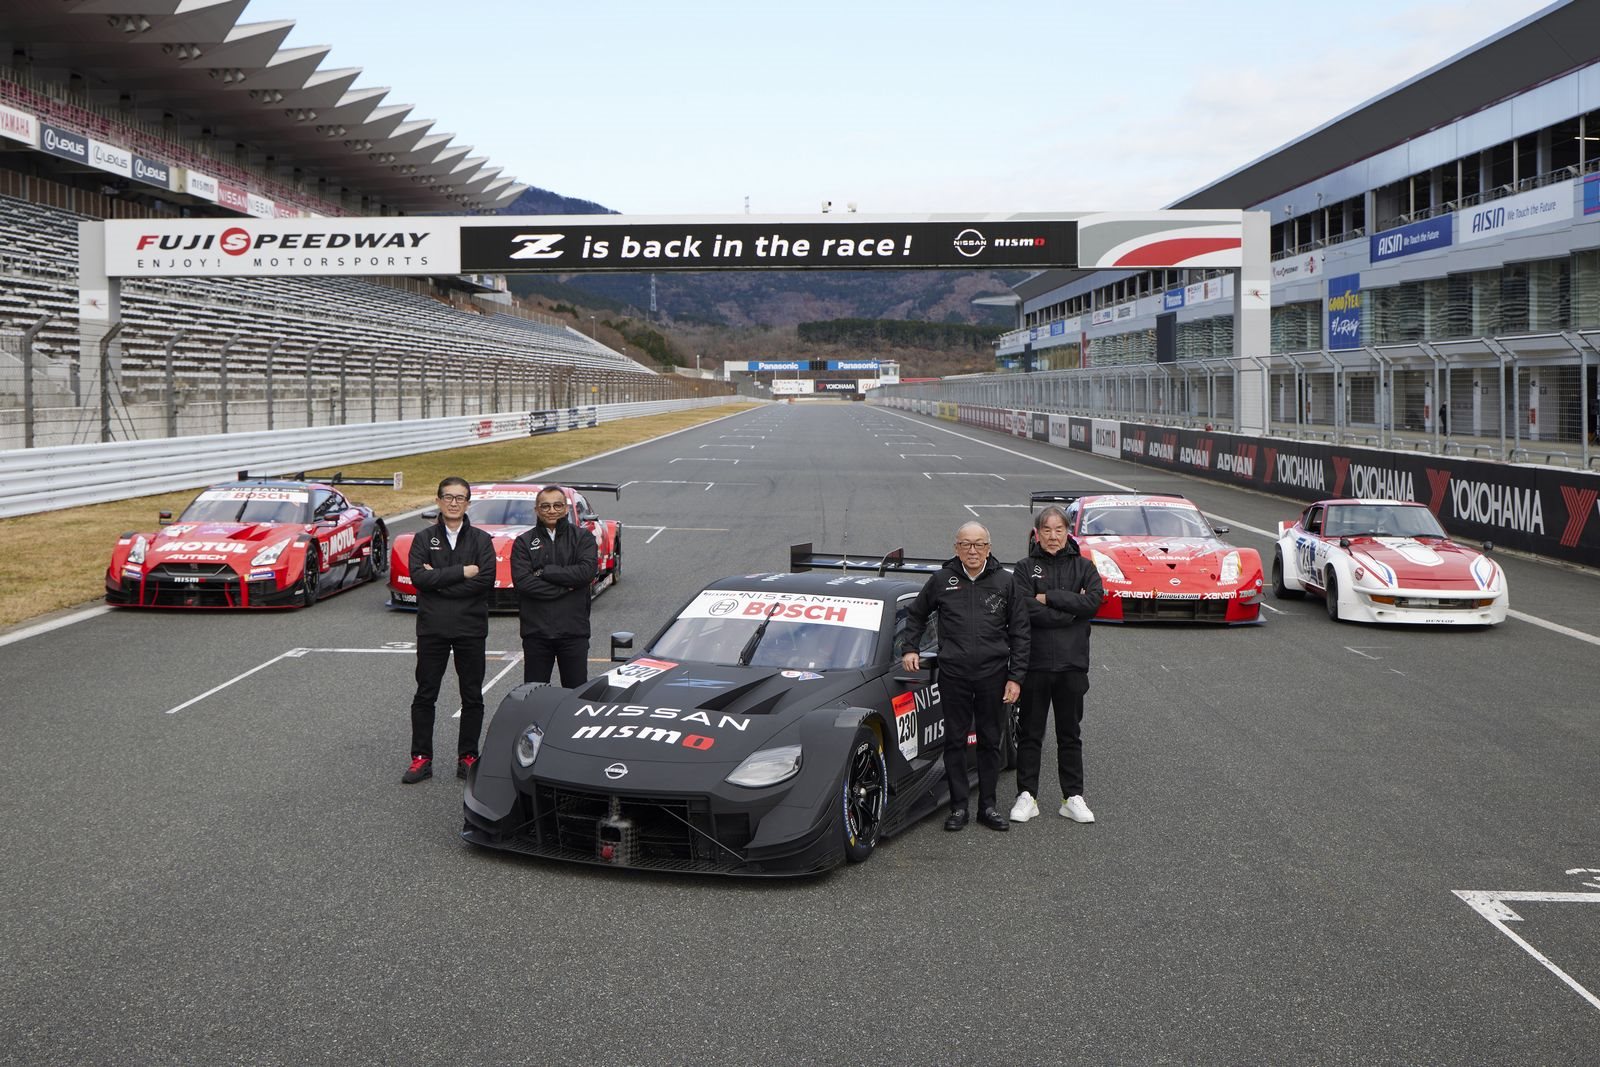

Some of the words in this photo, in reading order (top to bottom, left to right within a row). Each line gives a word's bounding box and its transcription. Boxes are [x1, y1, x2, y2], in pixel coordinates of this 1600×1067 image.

[1, 111, 31, 138] YAMAHA
[56, 136, 85, 155] LEXUS
[103, 151, 128, 168] LEXUS
[143, 165, 167, 181] LEXUS
[220, 187, 248, 210] NISSAN
[1472, 206, 1505, 234] AISIN
[1516, 207, 1530, 219] Touch
[1530, 205, 1539, 215] the
[1540, 201, 1556, 213] Future
[136, 235, 212, 251] FUJI
[220, 229, 431, 254] SPEEDWAY
[581, 236, 609, 259] is
[620, 235, 703, 259] back
[712, 235, 744, 257] in
[754, 234, 810, 257] the
[994, 238, 1045, 247] nismo
[1378, 233, 1403, 256] AISIN
[137, 258, 222, 269] ENJOY!
[253, 256, 429, 267] MOTORSPORTS
[758, 362, 799, 370] Panasonic
[838, 361, 879, 369] Panasonic
[1122, 438, 1144, 455] ADVAN
[1148, 441, 1174, 460] ADVAN
[1180, 446, 1209, 467] ADVAN
[1217, 452, 1253, 476] ADVAN
[1276, 453, 1326, 492] YOKOHAMA
[1349, 463, 1416, 502] YOKOHAMA
[233, 492, 290, 500] BOSCH
[1450, 478, 1545, 535] YOKOHAMA
[155, 541, 249, 554] MOTUL
[329, 526, 356, 556] MOTUL
[164, 553, 227, 561] AUTECH
[741, 592, 827, 603] NISSAN
[742, 601, 848, 622] BOSCH
[914, 682, 941, 713] NIS
[574, 704, 751, 731] NISSAN
[899, 711, 917, 745] 230
[571, 725, 715, 750] nismo
[923, 718, 945, 746] nis
